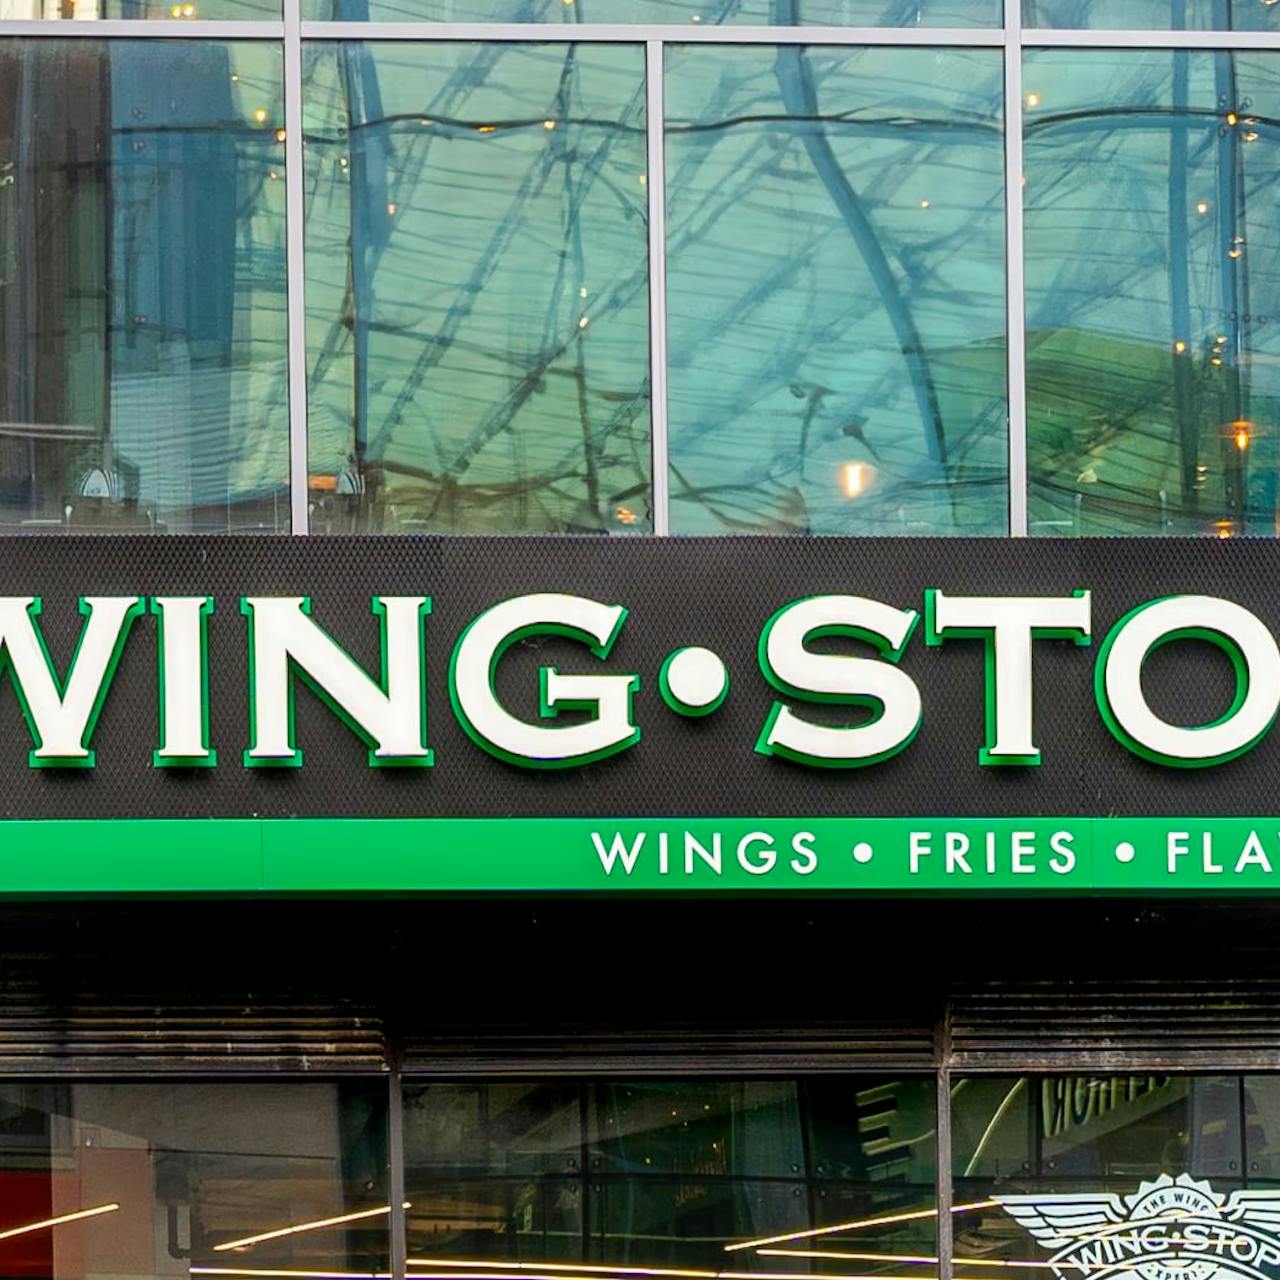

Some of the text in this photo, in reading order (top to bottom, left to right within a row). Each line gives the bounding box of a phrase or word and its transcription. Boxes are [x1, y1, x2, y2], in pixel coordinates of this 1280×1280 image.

[590, 830, 818, 876] WINGS
[908, 831, 1076, 874] FRIES
[1142, 1194, 1167, 1214] THE
